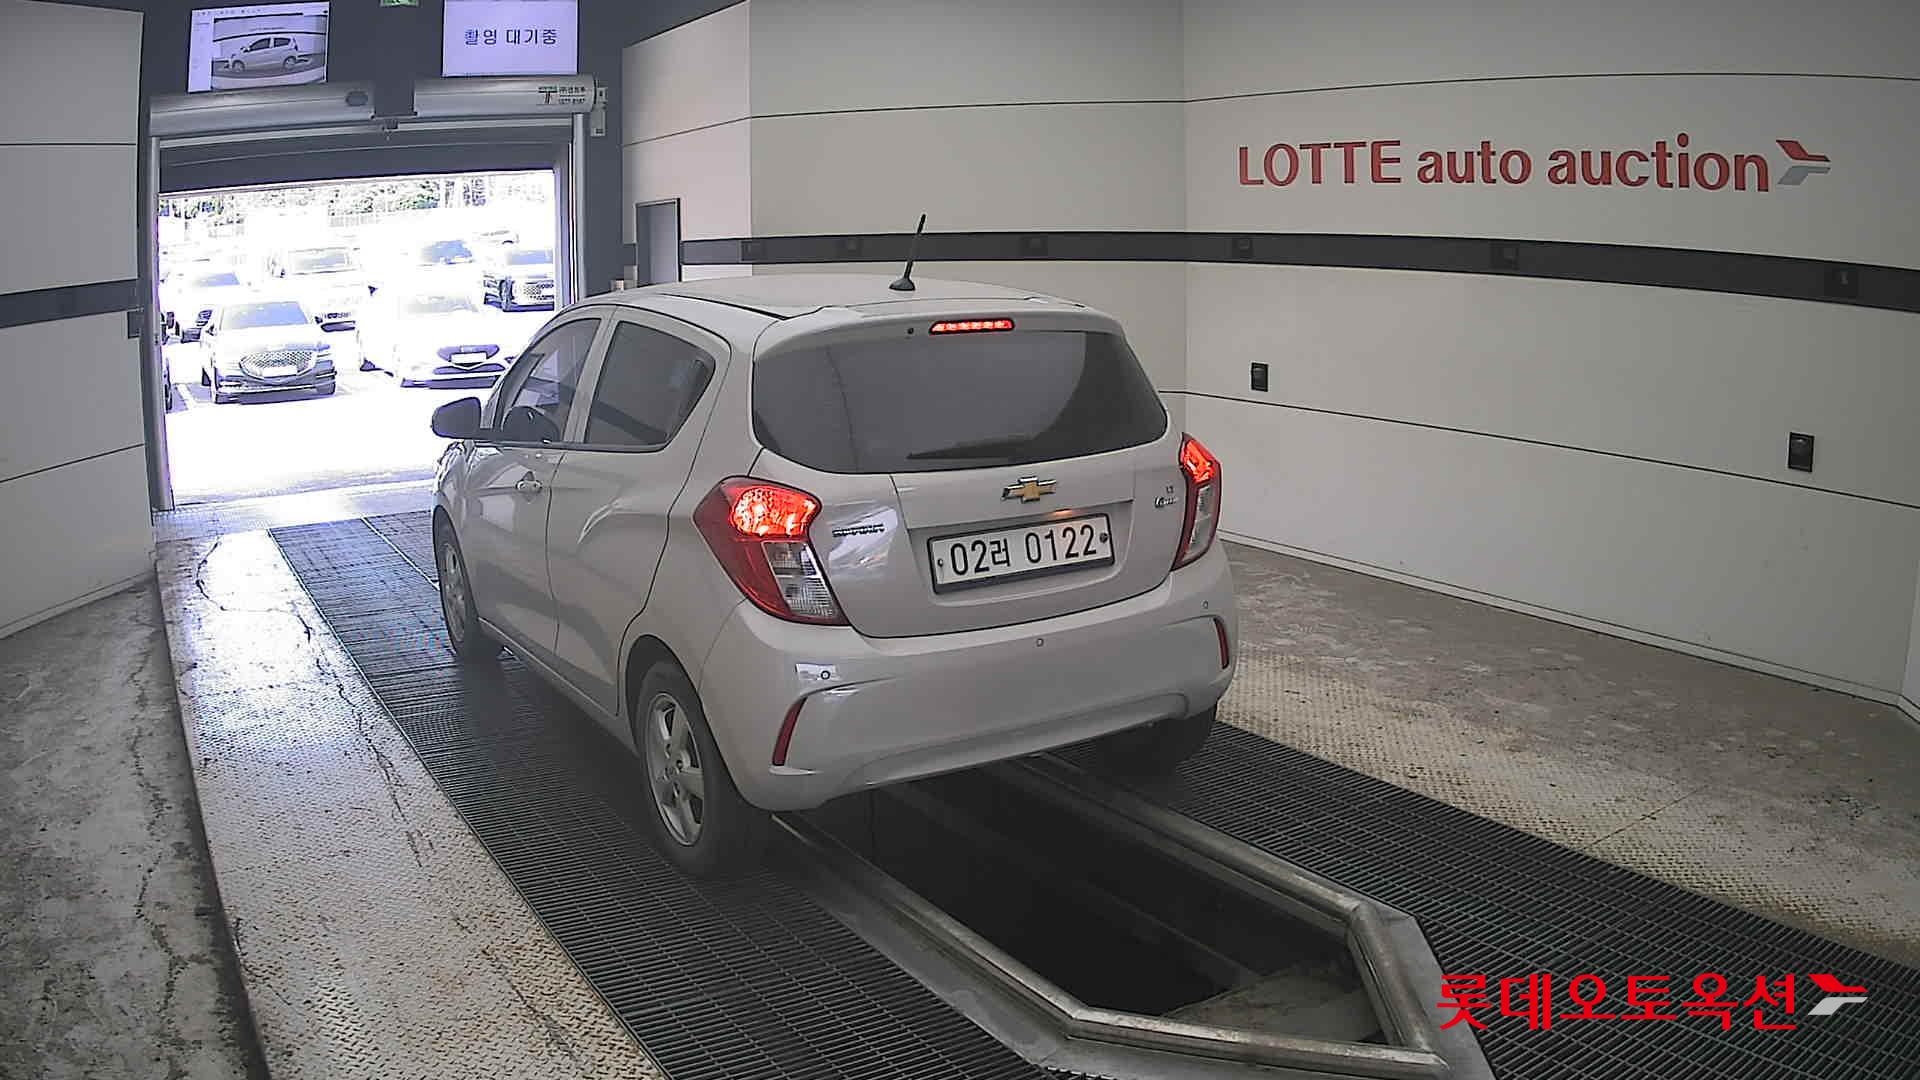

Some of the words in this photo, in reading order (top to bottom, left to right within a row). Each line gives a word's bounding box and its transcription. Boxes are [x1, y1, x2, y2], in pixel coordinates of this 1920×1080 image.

[506, 29, 557, 45] 대기중
[1239, 140, 1401, 187] LOTTE
[1417, 141, 1532, 185] auto
[1547, 132, 1769, 192] auction
[950, 538, 1011, 576] 02러
[1025, 524, 1097, 564] 0122
